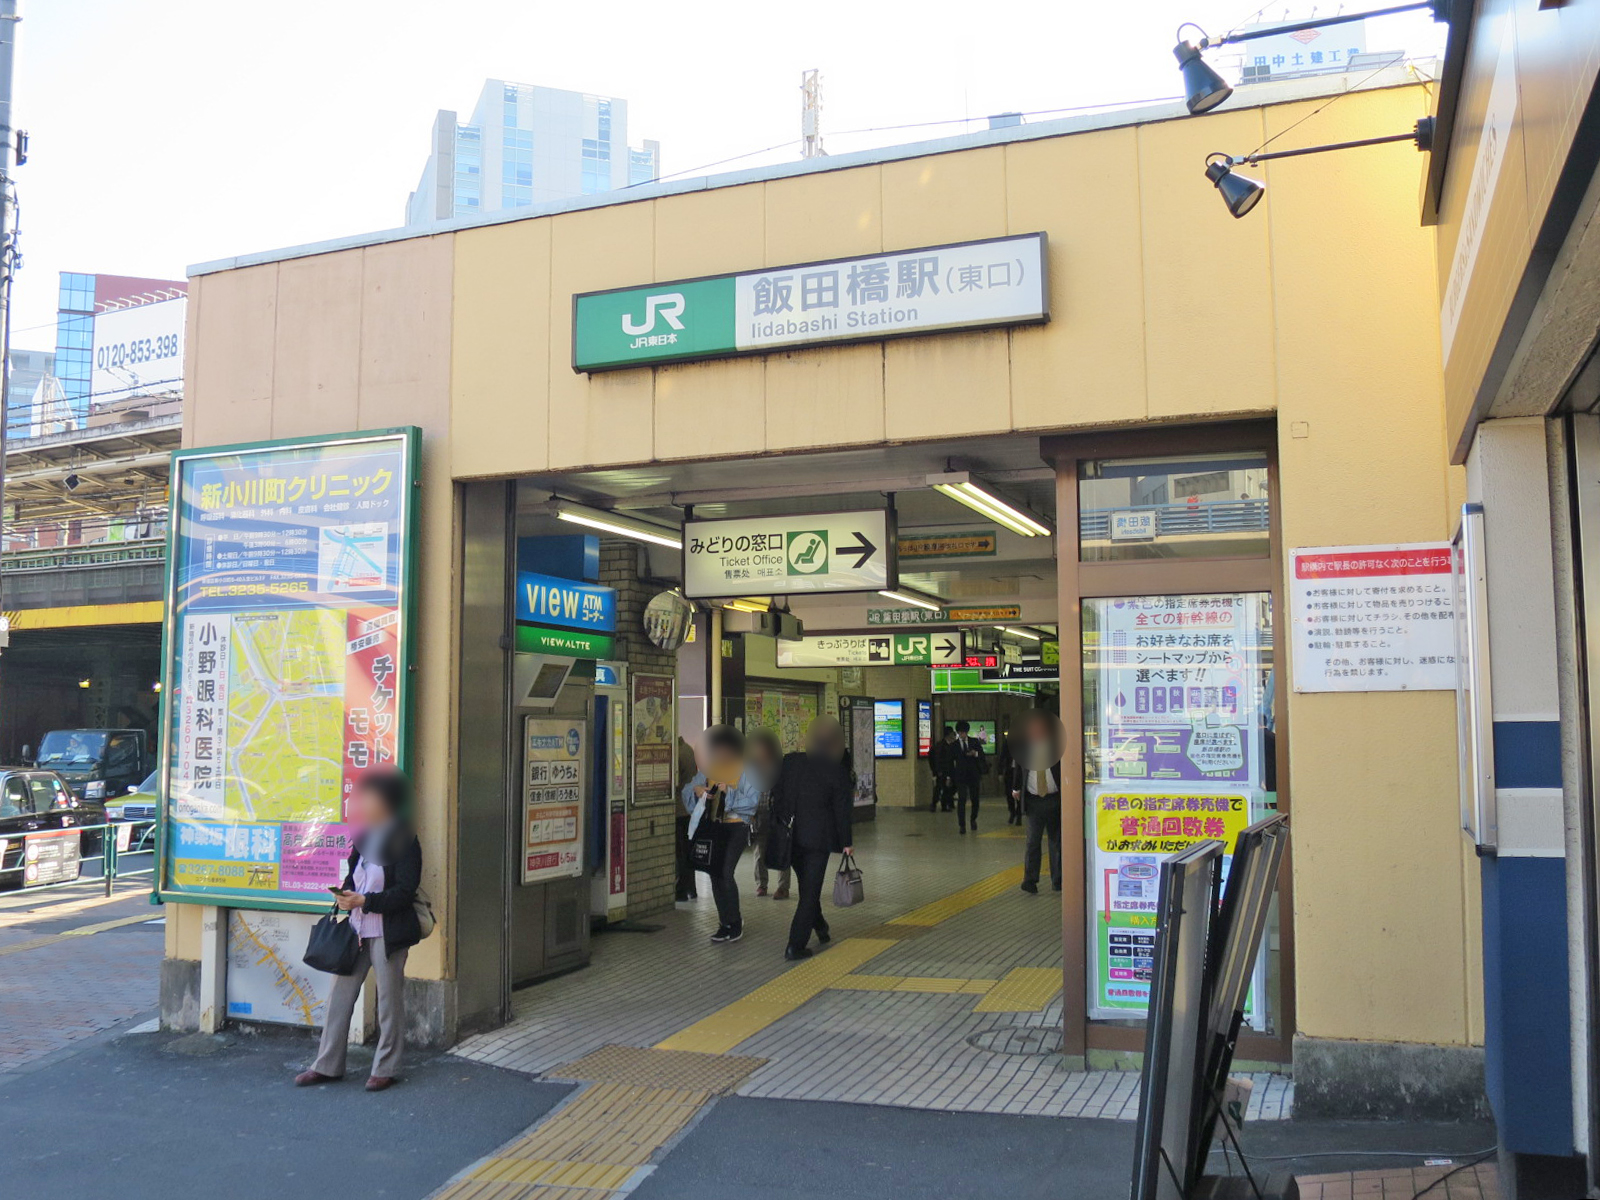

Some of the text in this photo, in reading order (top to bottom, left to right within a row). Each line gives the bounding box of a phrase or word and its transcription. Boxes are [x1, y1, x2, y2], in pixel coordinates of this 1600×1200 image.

[622, 292, 686, 335] JR
[752, 308, 918, 339] Iidabashi Station
[629, 333, 678, 349] JR東日本
[97, 333, 178, 369] 0120-853-398
[201, 468, 392, 510] 新小川町クリニック
[690, 534, 783, 555] みどりの窓口
[719, 554, 783, 568] Ticket Office
[1313, 584, 1447, 597] お客様に対して寄付を求めること。
[582, 593, 604, 612] ATM
[582, 609, 605, 623] コーナー
[1136, 611, 1233, 626] 全ての新幹線の
[541, 636, 591, 651] VIEW ALTTE
[816, 639, 868, 650] きっぷうりば
[897, 637, 928, 655] JR
[1136, 634, 1234, 648] お好きなお席を
[1136, 651, 1234, 665] シートマップから
[1324, 668, 1389, 678] 行為を禁じます。
[193, 621, 218, 790] 小野眼科医院
[348, 708, 370, 769] モモ
[531, 765, 578, 781] 銀行 ゆうちょ
[1102, 796, 1243, 813] 紫色の指定席券売機で
[1119, 816, 1226, 838] 普通回数券
[1113, 900, 1158, 911] 指定席券売
